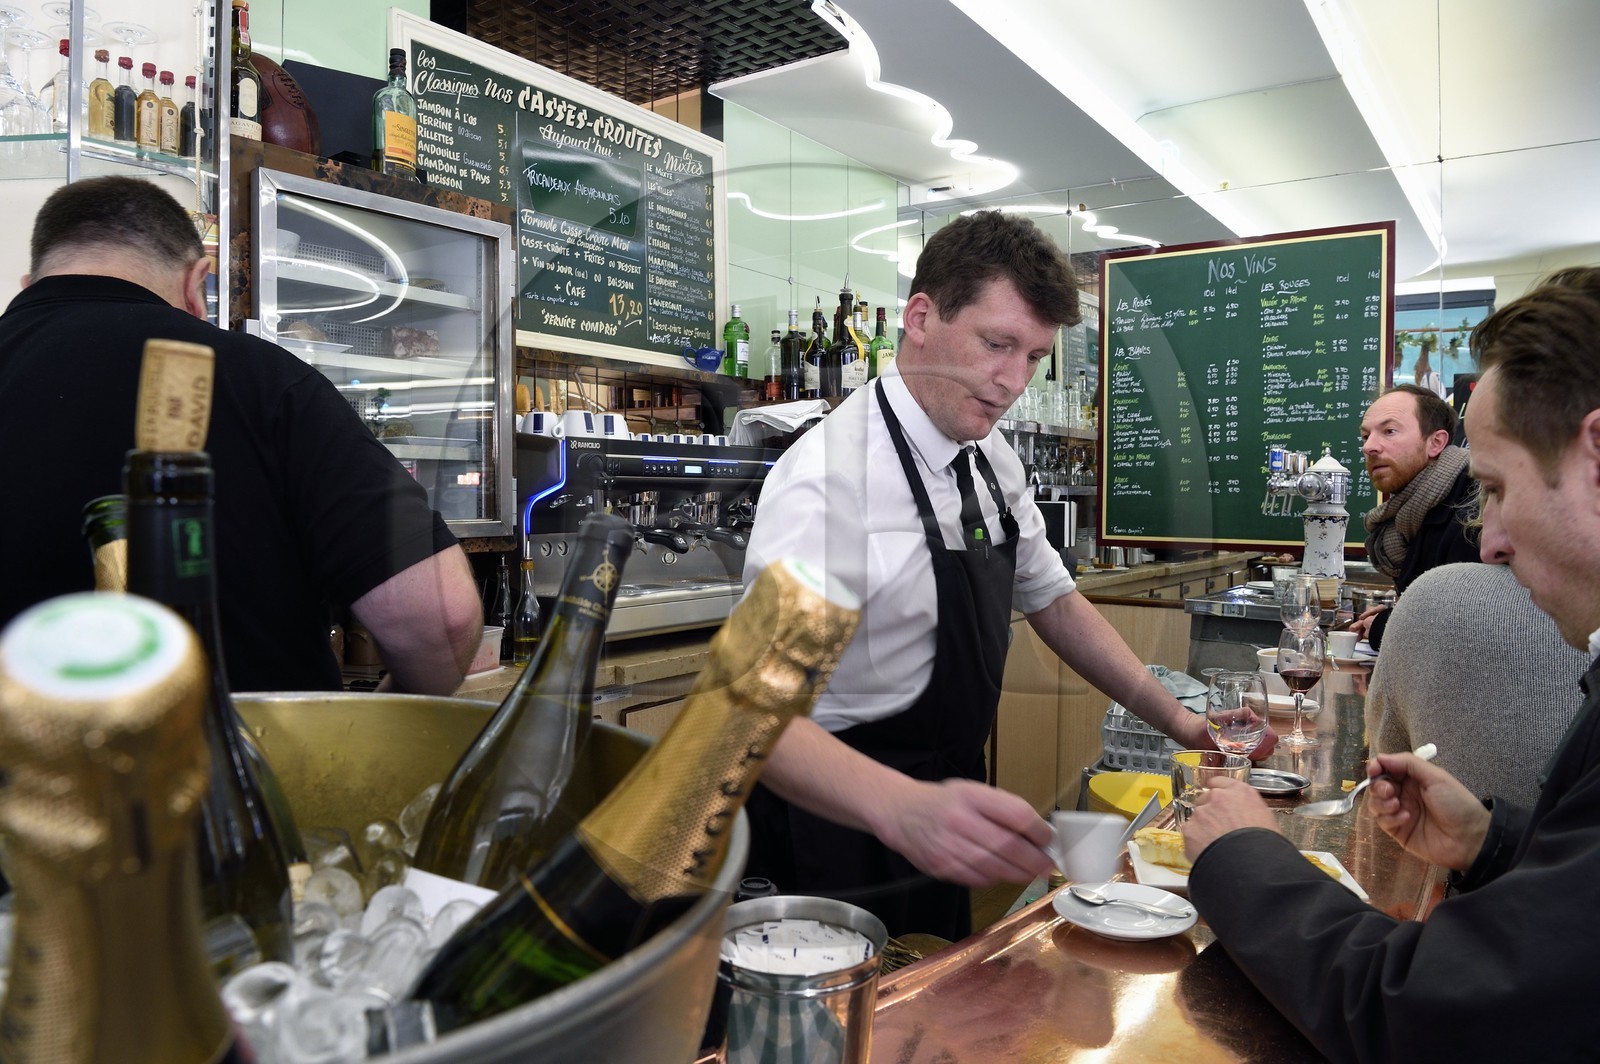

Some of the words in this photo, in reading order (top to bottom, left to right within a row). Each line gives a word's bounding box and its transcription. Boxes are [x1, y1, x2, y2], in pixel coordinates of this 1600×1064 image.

[417, 49, 436, 69] les
[413, 70, 481, 105] Classiques
[417, 112, 453, 132] TERRINE
[418, 99, 452, 118] JAMBON
[463, 113, 477, 126] L'OS
[484, 77, 514, 103] Nos
[517, 86, 662, 158] CASSES-CROUTES
[416, 125, 454, 146] RILLETTES
[417, 140, 461, 161] ANDOUILLE
[417, 153, 457, 174] JAMBON
[459, 169, 468, 177] DE
[470, 168, 491, 184] PAYS
[646, 163, 653, 172] LE
[655, 167, 673, 180] MIXTE
[663, 151, 704, 176] Mixtes
[648, 201, 654, 210] LE
[520, 208, 558, 233] Formule
[647, 219, 654, 229] LE
[655, 222, 671, 233] CORSE
[520, 235, 571, 257] CASSE-CROÛTE
[583, 250, 606, 266] FRITES
[616, 260, 642, 275] DESSERT
[648, 254, 679, 271] MARATHON
[532, 256, 545, 268] VIN
[546, 262, 555, 271] DU
[556, 260, 574, 276] JOUR
[593, 273, 602, 283] OU
[607, 275, 635, 290] BOISSON
[648, 273, 655, 284] LE
[1207, 257, 1236, 285] NOS
[1246, 254, 1278, 277] VINS
[565, 280, 587, 299] CAFÉ
[1260, 282, 1275, 293] LES
[1279, 279, 1311, 290] ROUGES
[608, 292, 643, 321] 13,20
[1116, 298, 1129, 312] LES
[1132, 294, 1153, 309] ROSÉS
[1127, 345, 1152, 357] BLANCS
[577, 441, 601, 449] RANCILIO
